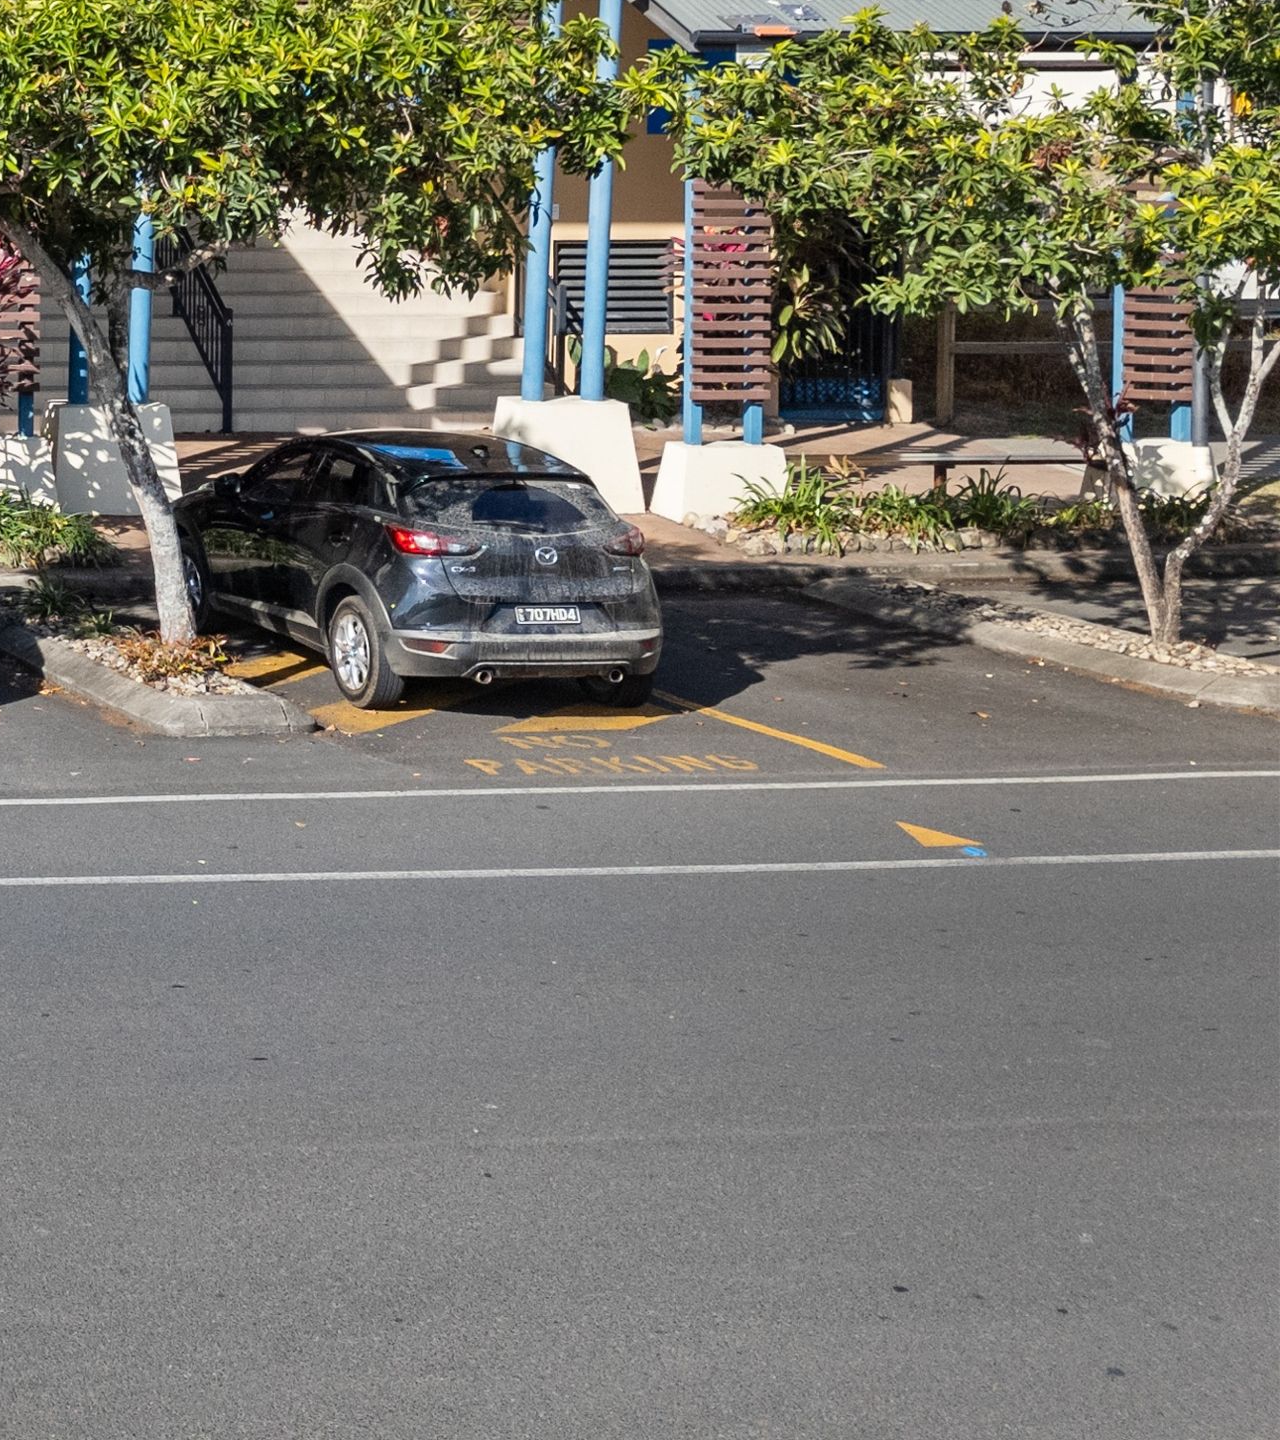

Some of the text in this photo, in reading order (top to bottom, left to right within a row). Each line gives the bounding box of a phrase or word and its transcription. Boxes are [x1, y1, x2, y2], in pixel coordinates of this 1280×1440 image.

[525, 608, 577, 621] 707HD4
[498, 735, 611, 750] NO
[463, 754, 759, 776] PARKING
